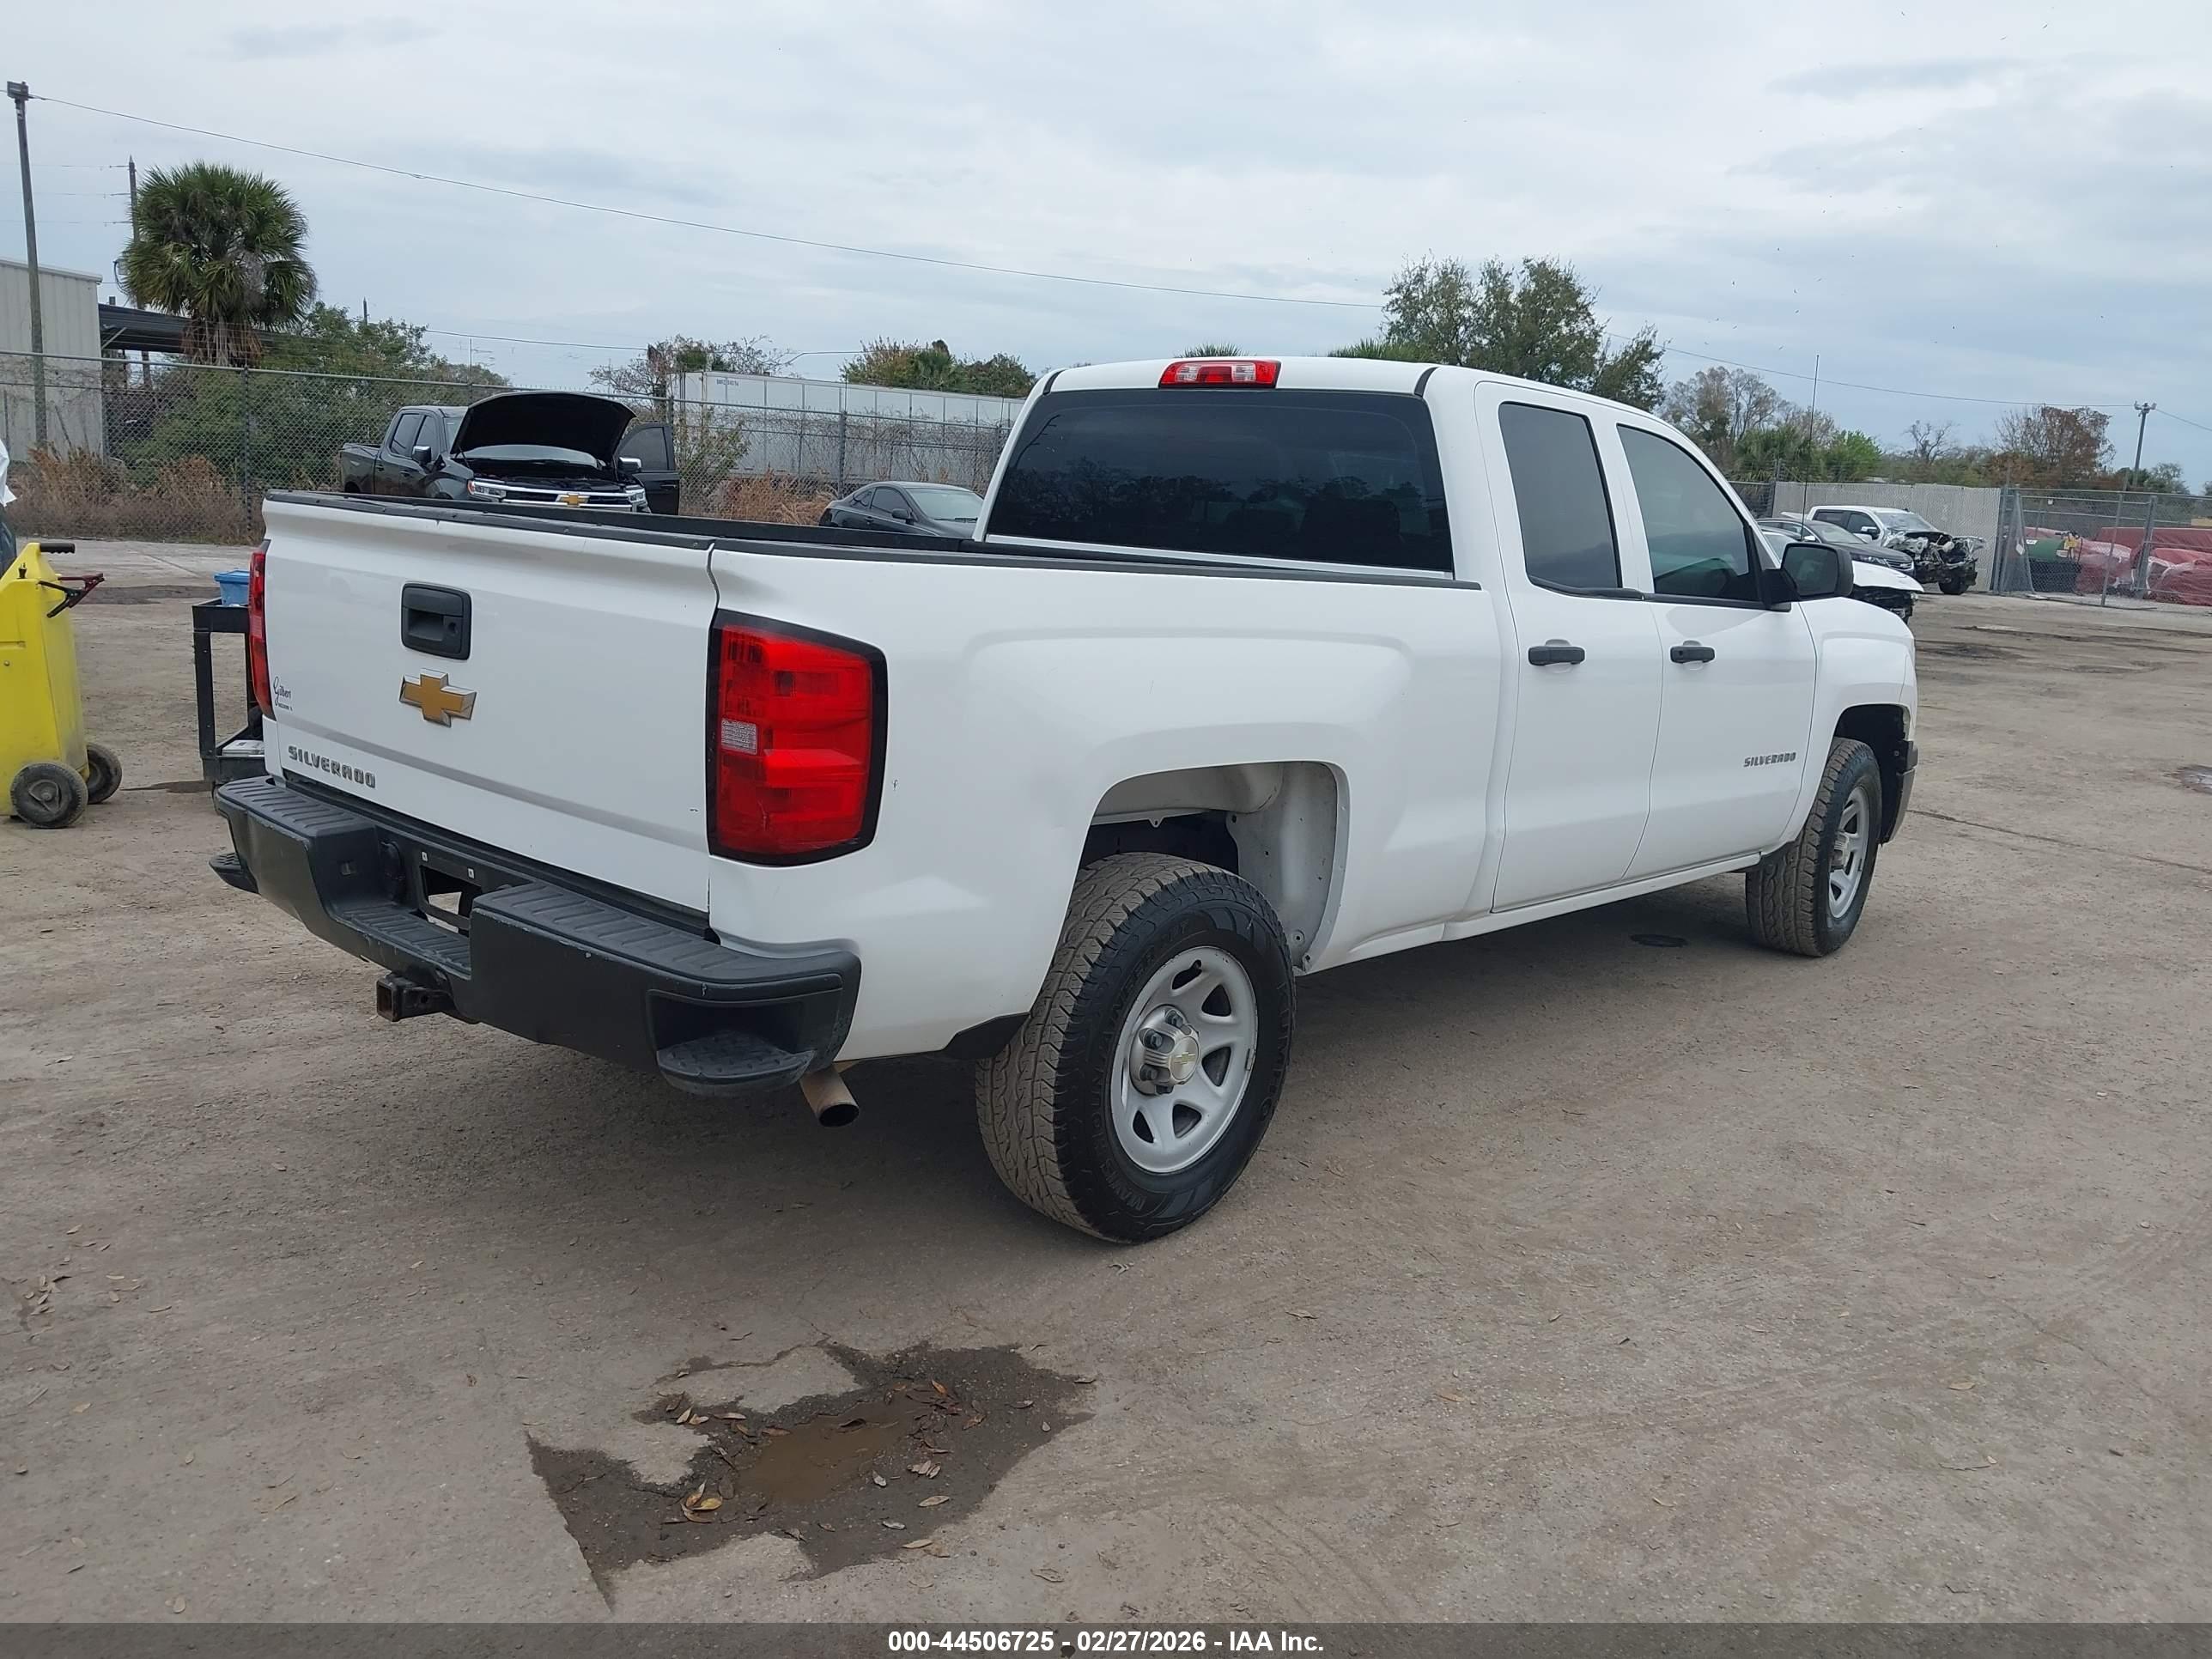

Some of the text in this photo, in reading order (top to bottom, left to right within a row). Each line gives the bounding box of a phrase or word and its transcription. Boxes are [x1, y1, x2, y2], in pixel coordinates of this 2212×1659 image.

[288, 744, 376, 788] SILVERADO
[1743, 751, 1796, 768] SILVERADO
[1099, 1157, 1148, 1212] MAVIS
